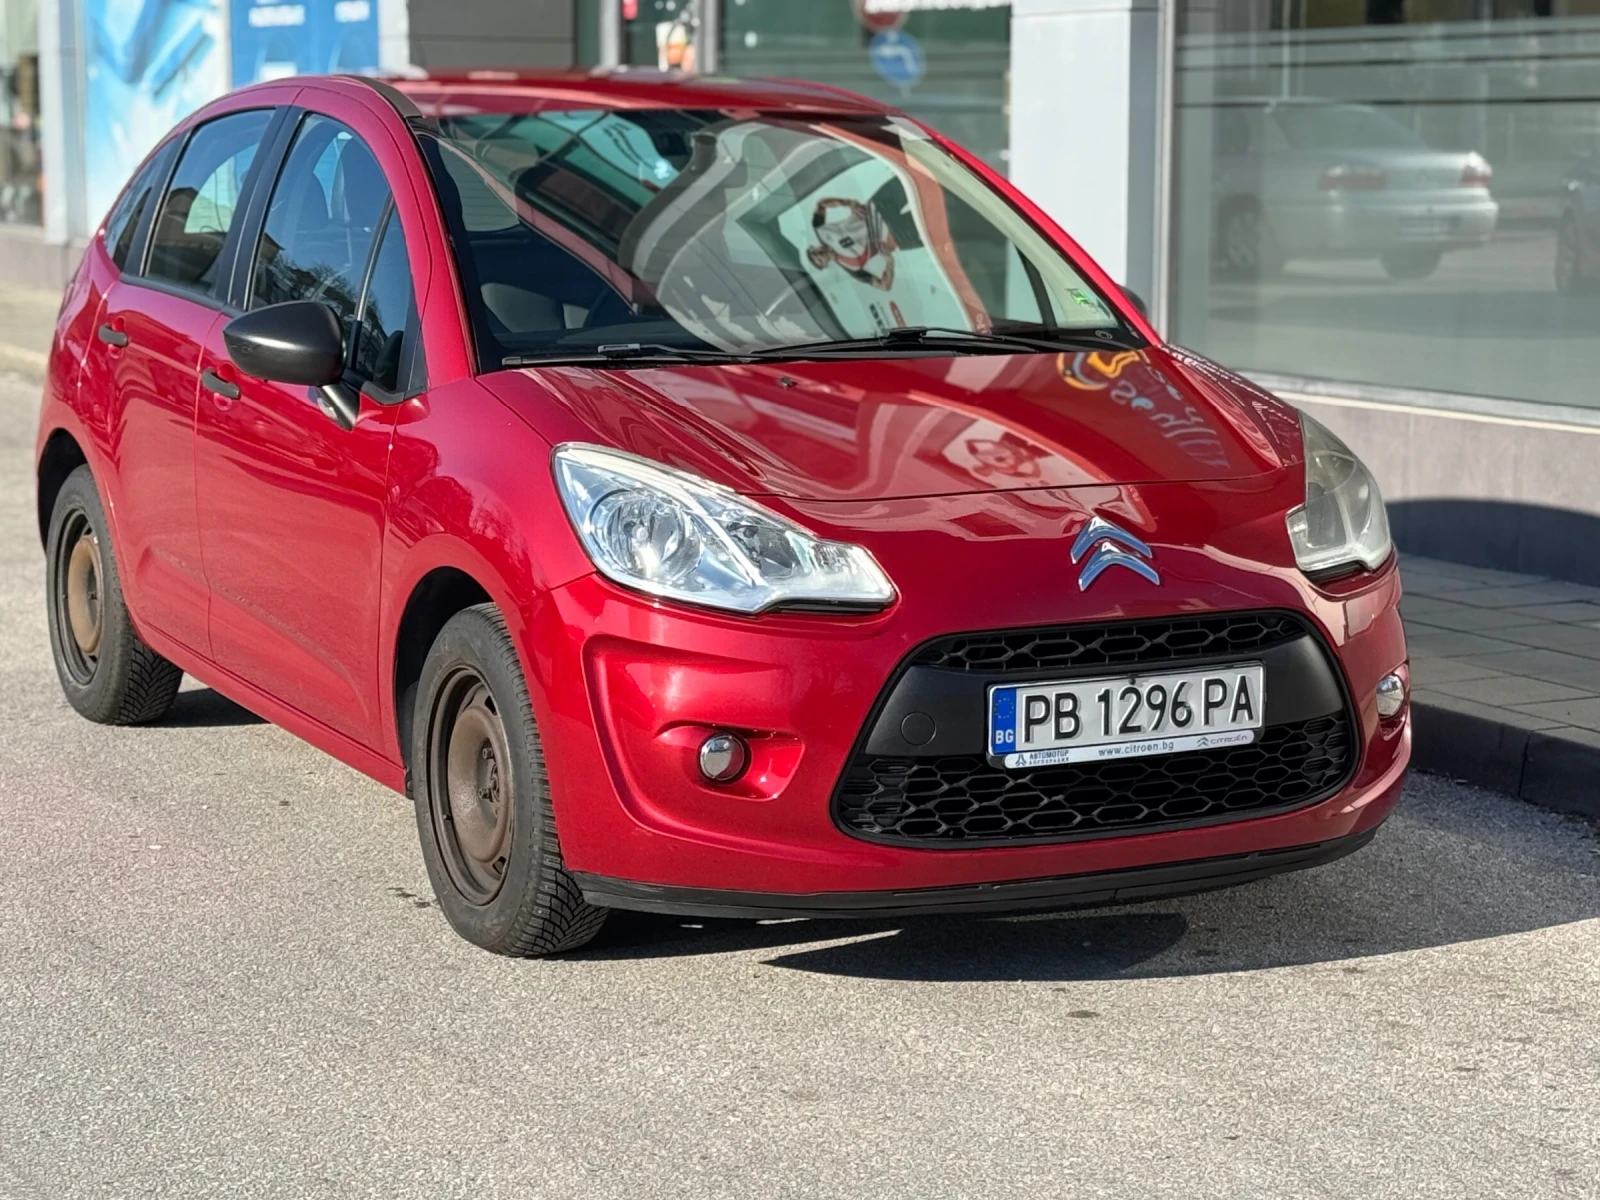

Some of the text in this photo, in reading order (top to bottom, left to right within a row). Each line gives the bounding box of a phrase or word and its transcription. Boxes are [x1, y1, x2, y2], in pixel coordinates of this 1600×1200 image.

[1023, 675, 1254, 743] PB 1296 PA
[995, 728, 1014, 745] BG
[1098, 741, 1174, 757] www.citroen.bg
